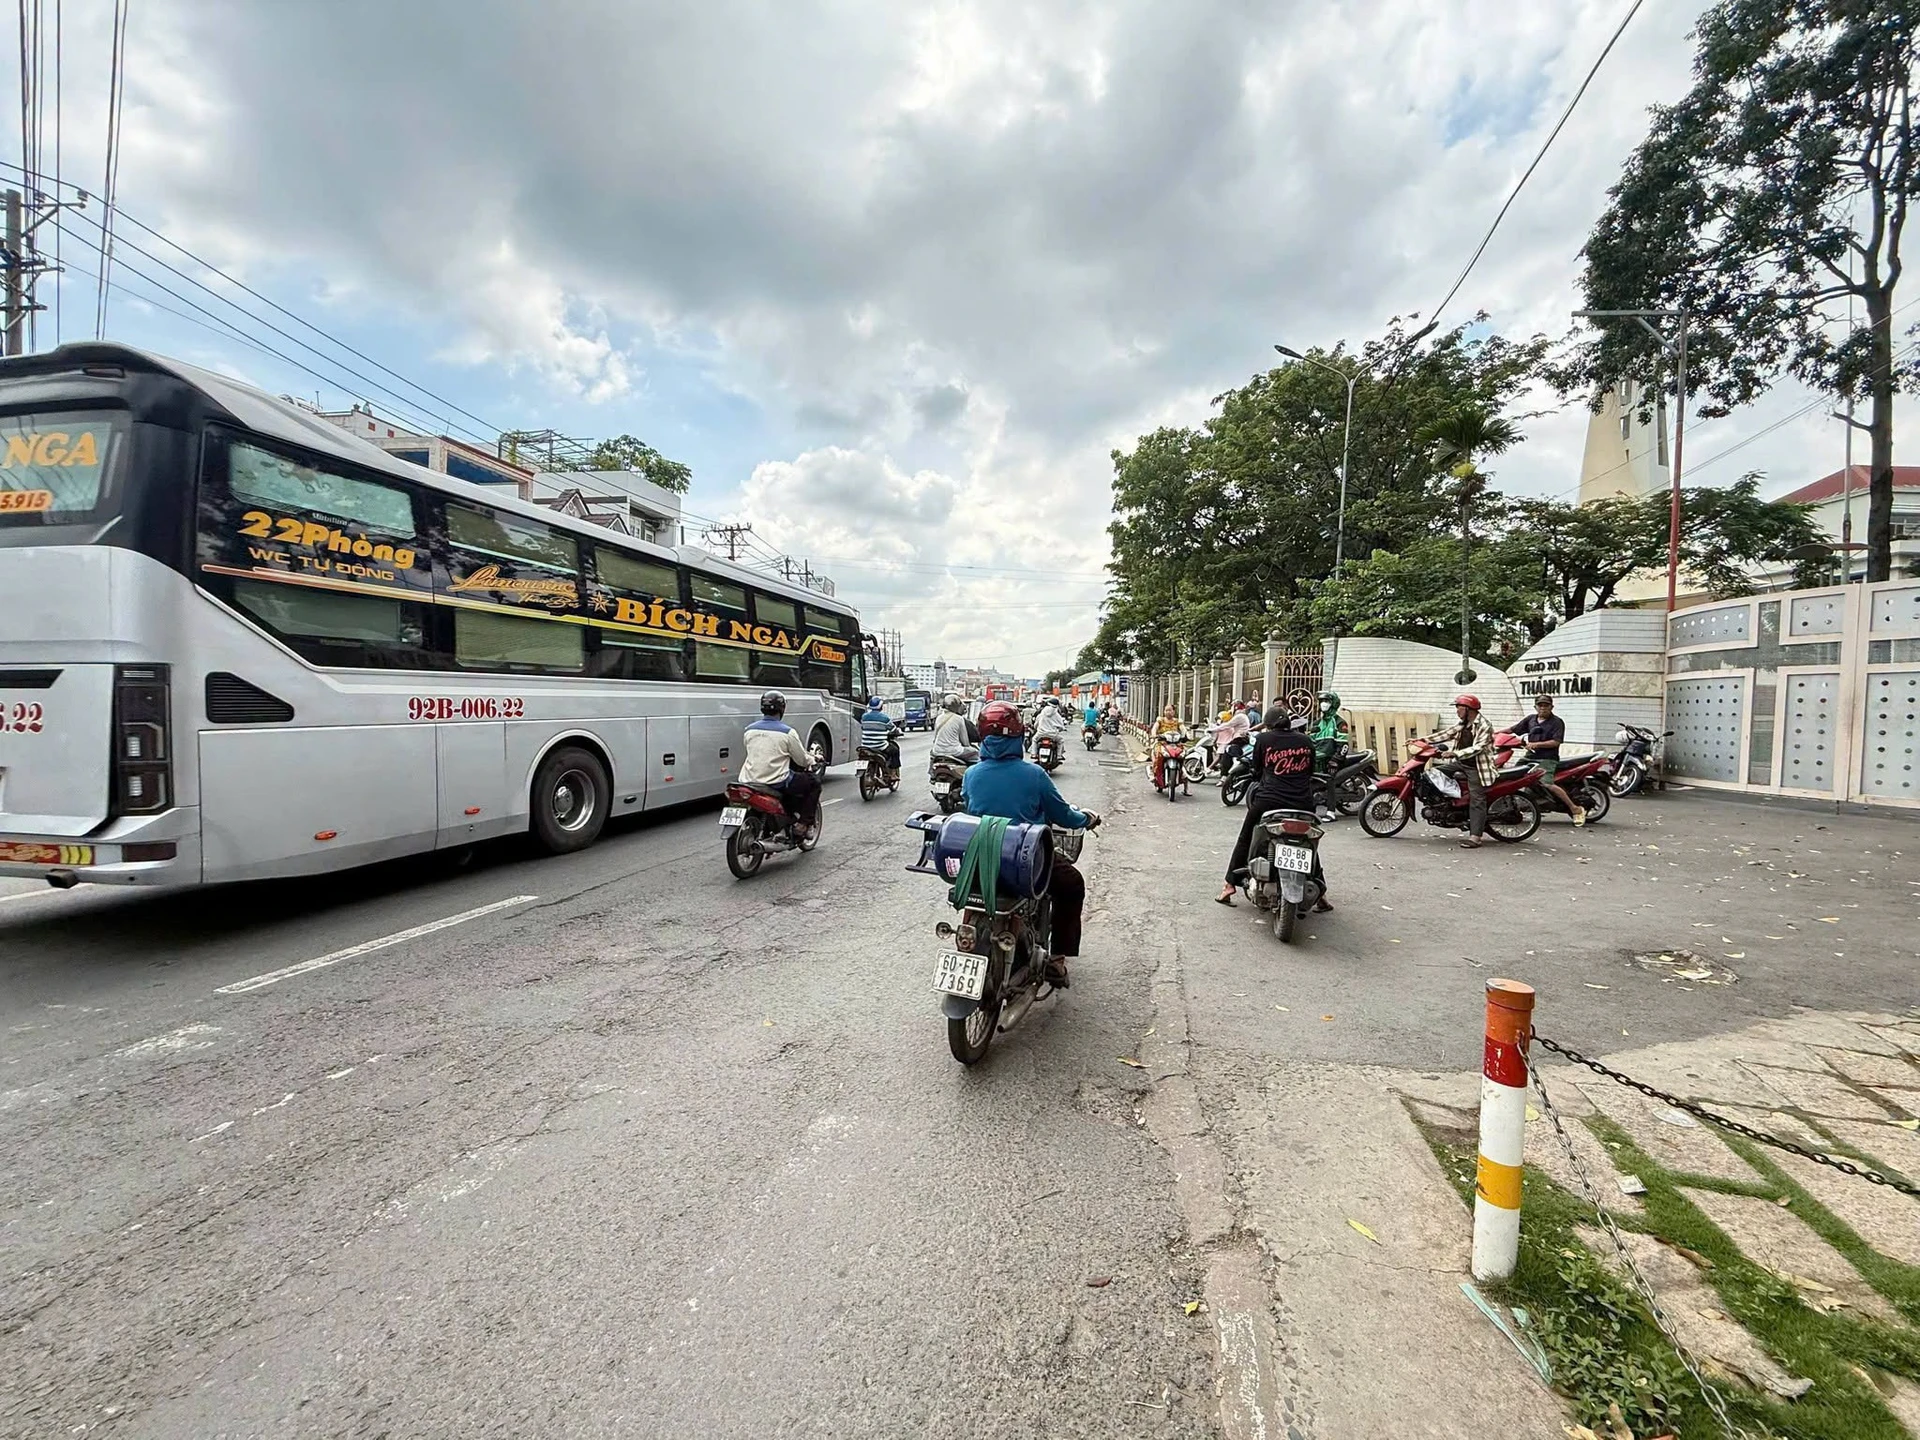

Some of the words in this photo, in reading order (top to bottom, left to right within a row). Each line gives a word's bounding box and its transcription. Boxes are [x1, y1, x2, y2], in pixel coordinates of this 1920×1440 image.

[0, 431, 98, 469] NGA
[248, 547, 291, 564] WC
[446, 563, 578, 599] Limousine
[613, 597, 719, 636] BÍCH
[730, 620, 792, 648] NGA
[1524, 659, 1545, 673] GIÁO
[1519, 675, 1560, 695] THÁNH
[1562, 673, 1592, 693] TÂM
[408, 696, 524, 720] 92B-006.22
[1277, 857, 1309, 871] 626.99
[938, 972, 975, 994] 7369
